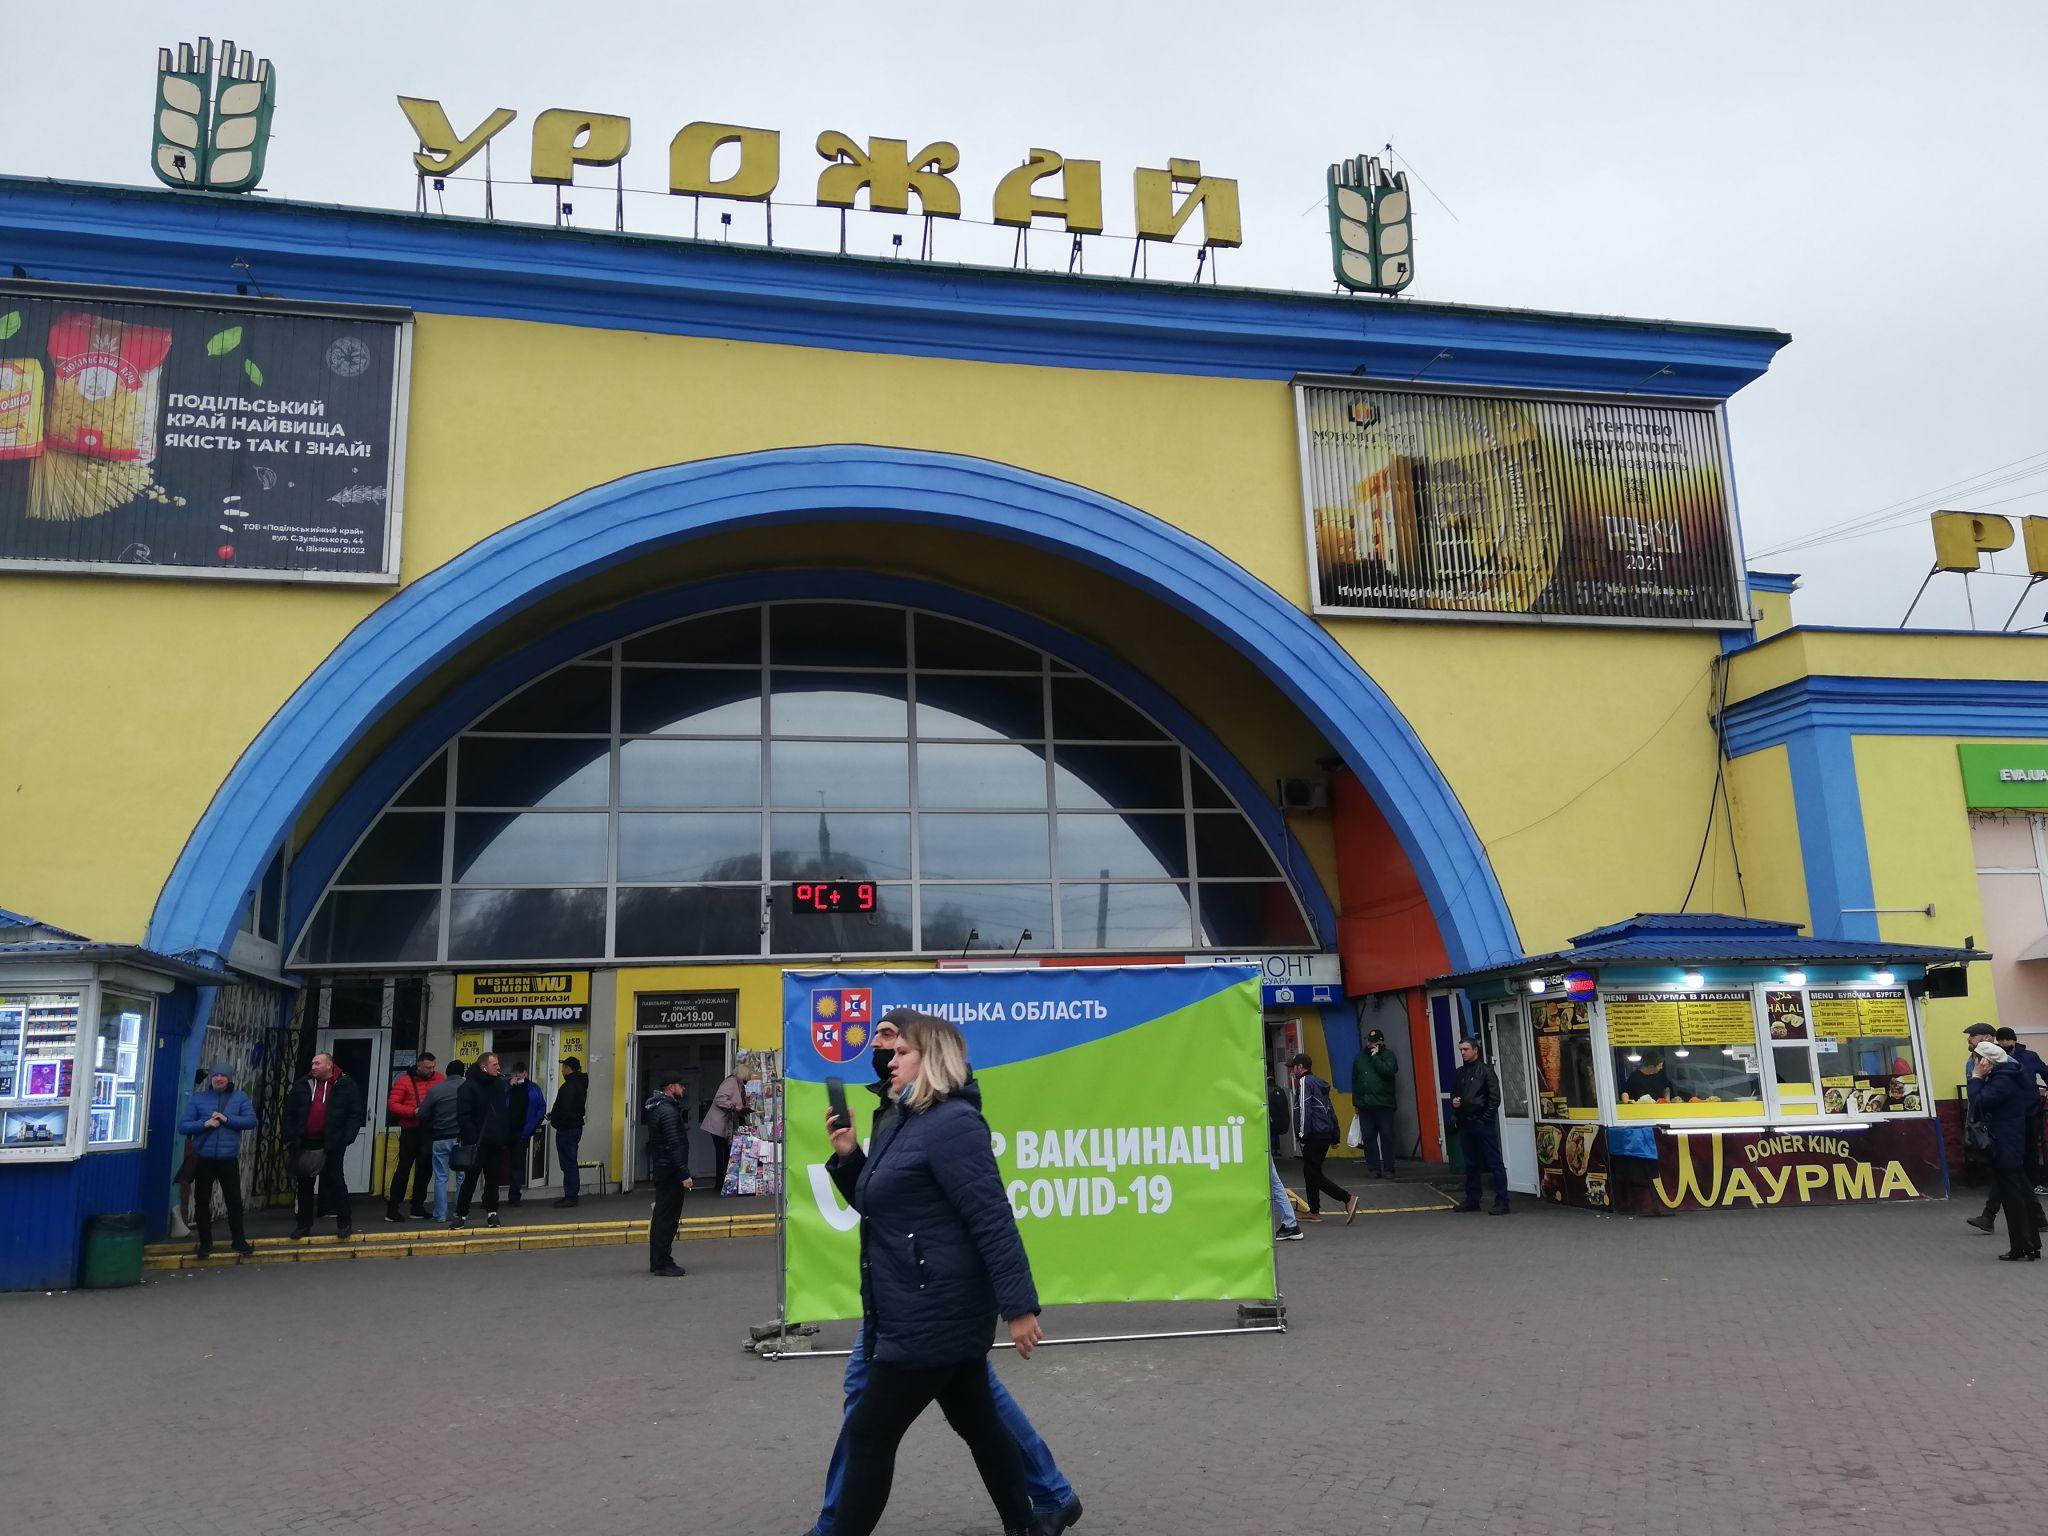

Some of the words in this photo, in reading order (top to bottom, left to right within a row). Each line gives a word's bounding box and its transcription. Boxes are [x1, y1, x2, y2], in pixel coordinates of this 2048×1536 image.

[397, 95, 1242, 249] УРОЖАЙ
[168, 393, 325, 416] ПОДІЛЬСЬКИЙ
[166, 413, 226, 429] КРАЙ
[232, 416, 346, 438] НАЙВИЩА
[1584, 417, 1673, 437] Агентство
[165, 433, 241, 450] ЯКІСТЬ
[246, 438, 289, 453] ТАК
[294, 441, 300, 454] І
[306, 440, 371, 458] ЗНАЙ!
[857, 884, 873, 910] 9
[477, 977, 530, 986] WESTERN
[535, 976, 567, 992] WU
[493, 984, 530, 993] UNION
[1838, 991, 1871, 999] БУЛОЧКА
[1876, 991, 1902, 999] БУРГЕР
[474, 995, 518, 1004] ГРОШОВІ
[521, 994, 570, 1003] ПЕРЕКАЗИ
[1604, 994, 1628, 1002] MENU
[1638, 993, 1687, 1001] ШАУРМА
[1767, 1003, 1803, 1014] HALAL
[461, 1008, 518, 1022] ОБМІН
[522, 1007, 583, 1021] ВАЛЮТ
[661, 1011, 714, 1023] 7.00-19.00
[1011, 999, 1108, 1021] ОБЛАСТЬ
[1016, 1115, 1245, 1172] ВАКЦИНАЦІЇ
[1808, 1134, 1850, 1158] KING
[1653, 1132, 1919, 1209] ШАУРМА
[1006, 1174, 1173, 1220] COVID-19
